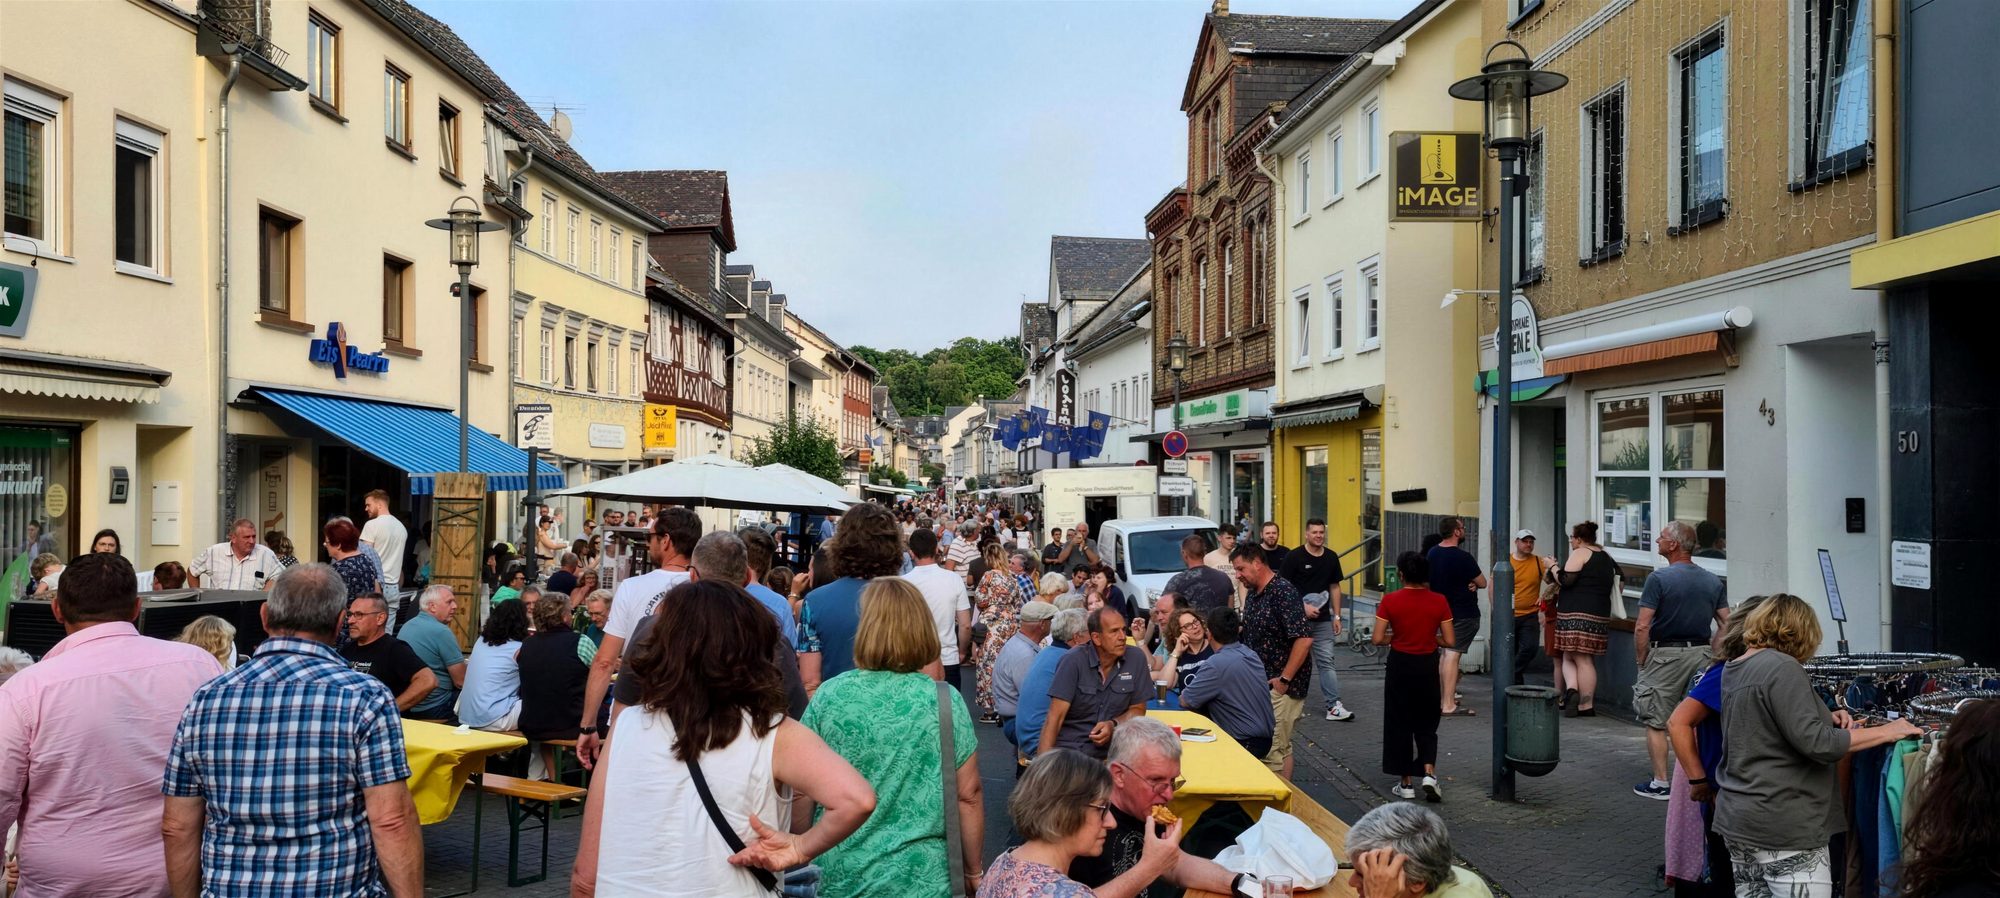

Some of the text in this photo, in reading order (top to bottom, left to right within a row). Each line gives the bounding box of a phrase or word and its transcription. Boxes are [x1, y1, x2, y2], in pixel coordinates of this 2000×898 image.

[1398, 186, 1478, 207] iMAGE
[318, 339, 339, 363] Eis
[1758, 397, 1776, 426] 43
[1897, 430, 1919, 453] 50
